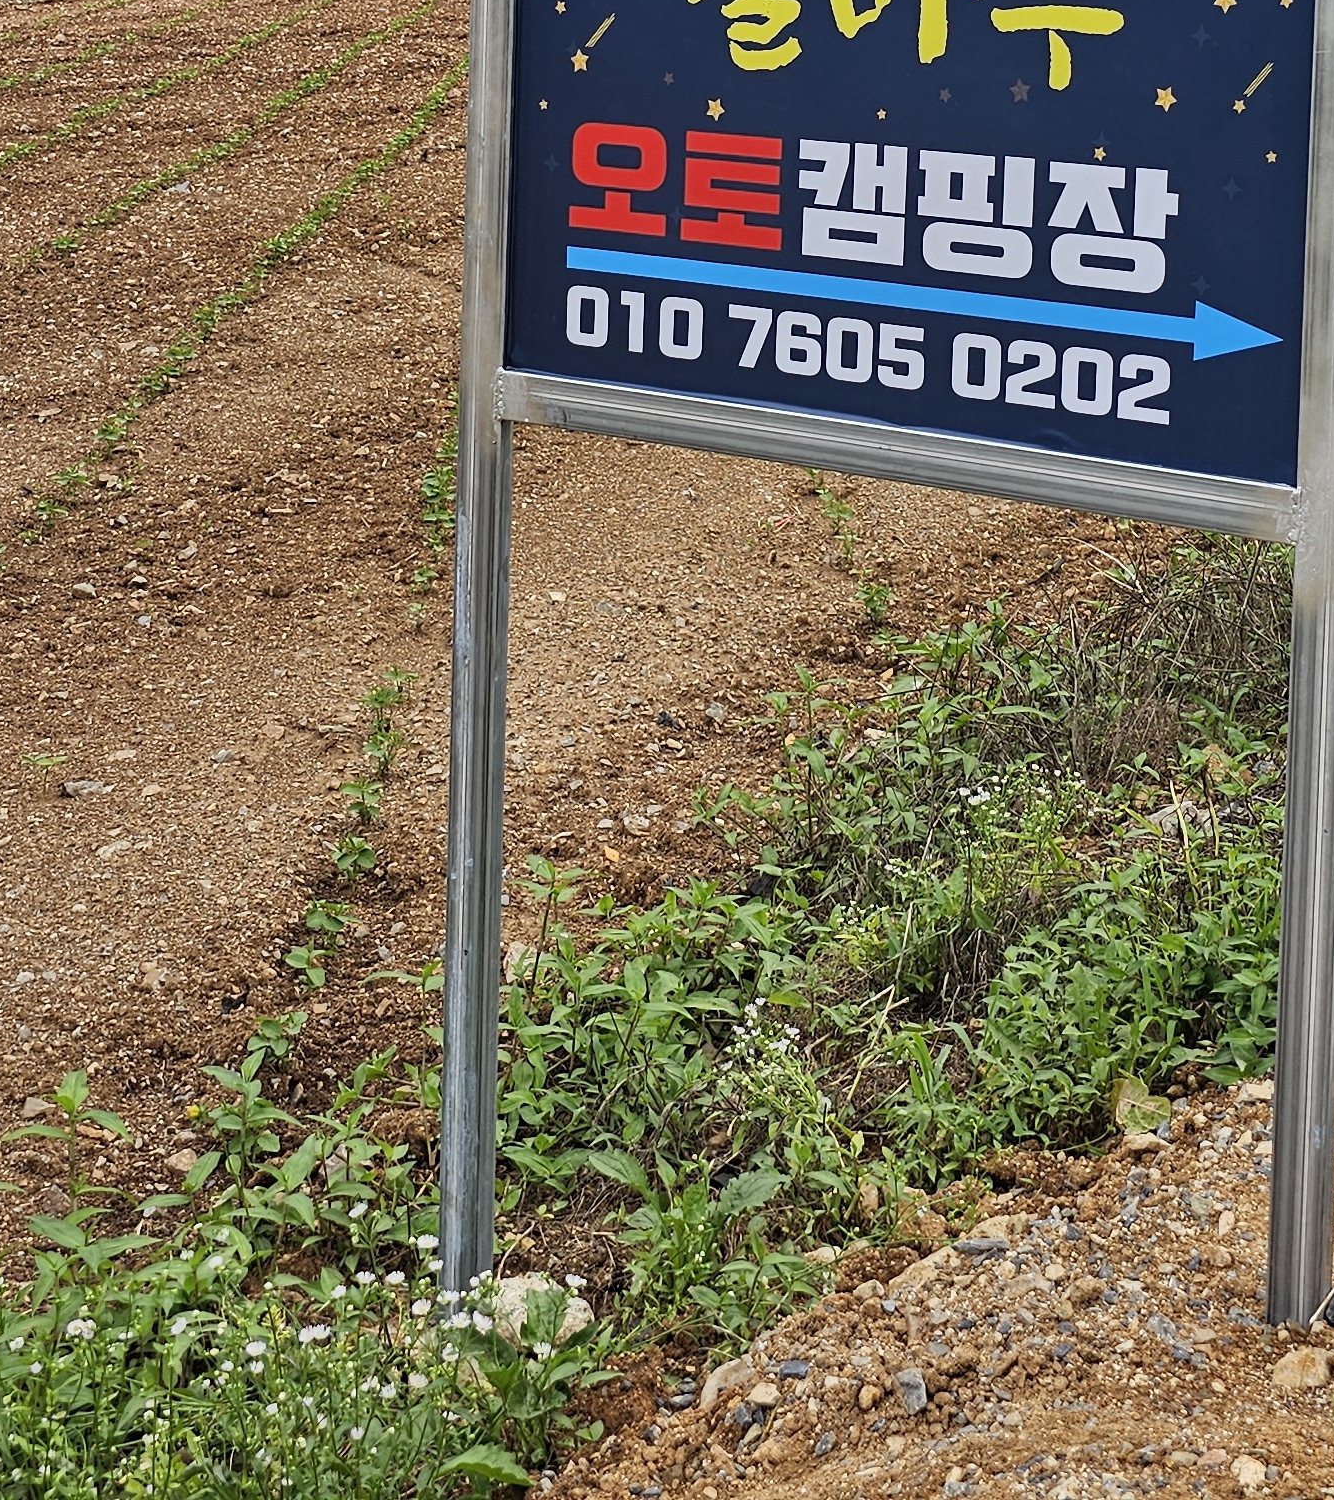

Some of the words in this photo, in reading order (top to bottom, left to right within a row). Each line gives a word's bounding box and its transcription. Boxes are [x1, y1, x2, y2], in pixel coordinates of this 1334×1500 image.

[569, 122, 1179, 293] 오토캠핑장
[566, 285, 703, 360] 010
[729, 304, 924, 390] 7605
[952, 333, 1170, 425] 0202
